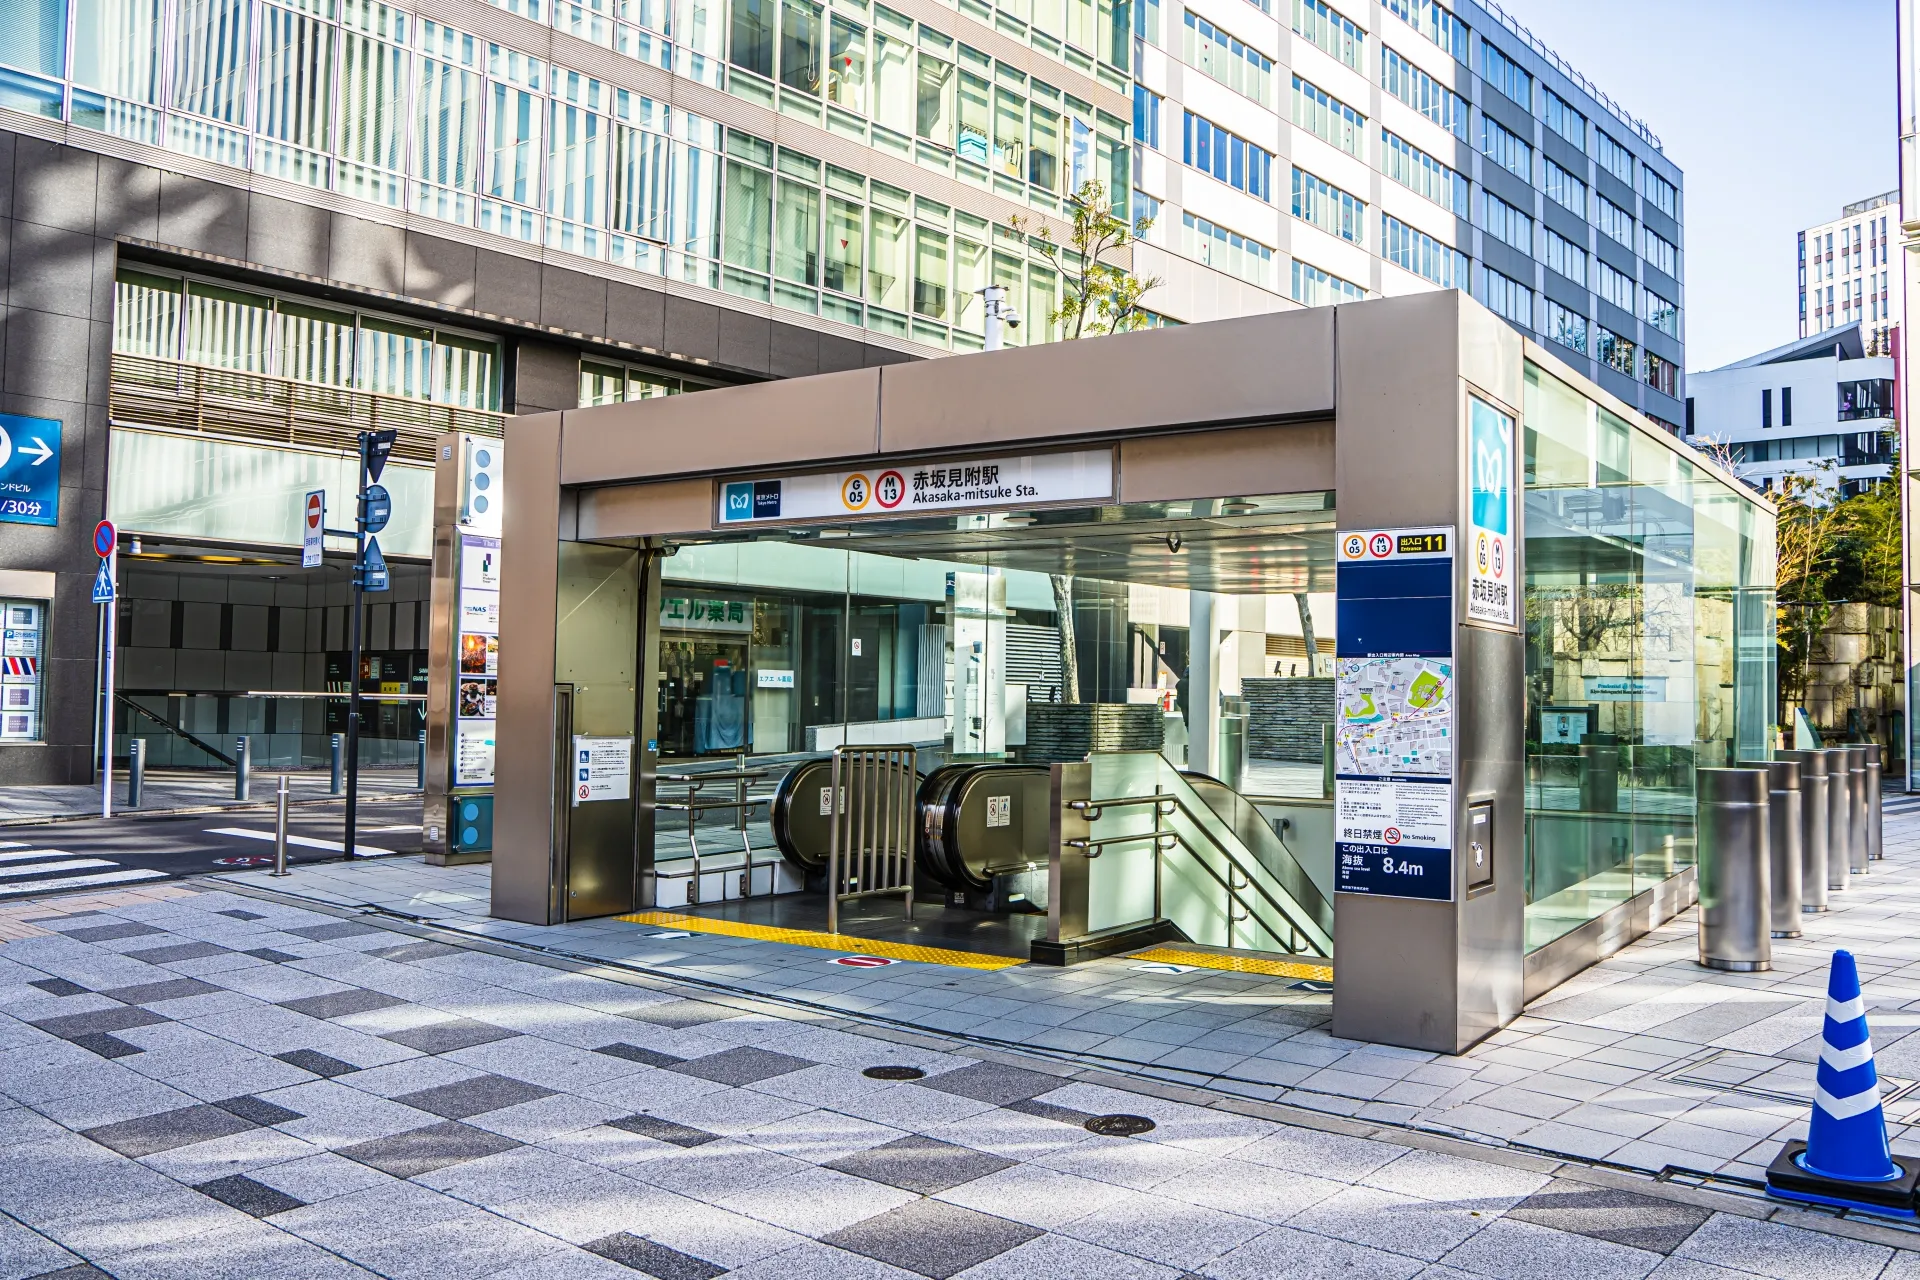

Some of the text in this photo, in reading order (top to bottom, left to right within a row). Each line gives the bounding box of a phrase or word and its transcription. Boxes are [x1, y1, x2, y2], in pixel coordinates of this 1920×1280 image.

[885, 477, 895, 488] M
[913, 465, 999, 491] 赤坂見附駅
[852, 479, 861, 490] G
[755, 493, 779, 501] 東京メトロ
[849, 492, 863, 503] 05
[884, 488, 897, 500] 13
[913, 484, 1039, 504] Akasaka-mitsuke Sta.
[1377, 537, 1385, 545] M
[1400, 535, 1443, 551] 出入口 11
[1472, 577, 1508, 606] 赤坂見附駅
[1343, 827, 1383, 841] 終日禁煙
[1411, 834, 1436, 843] Smoking
[1342, 844, 1389, 855] この出入口は
[1341, 854, 1424, 876] 海抜 8.4m
